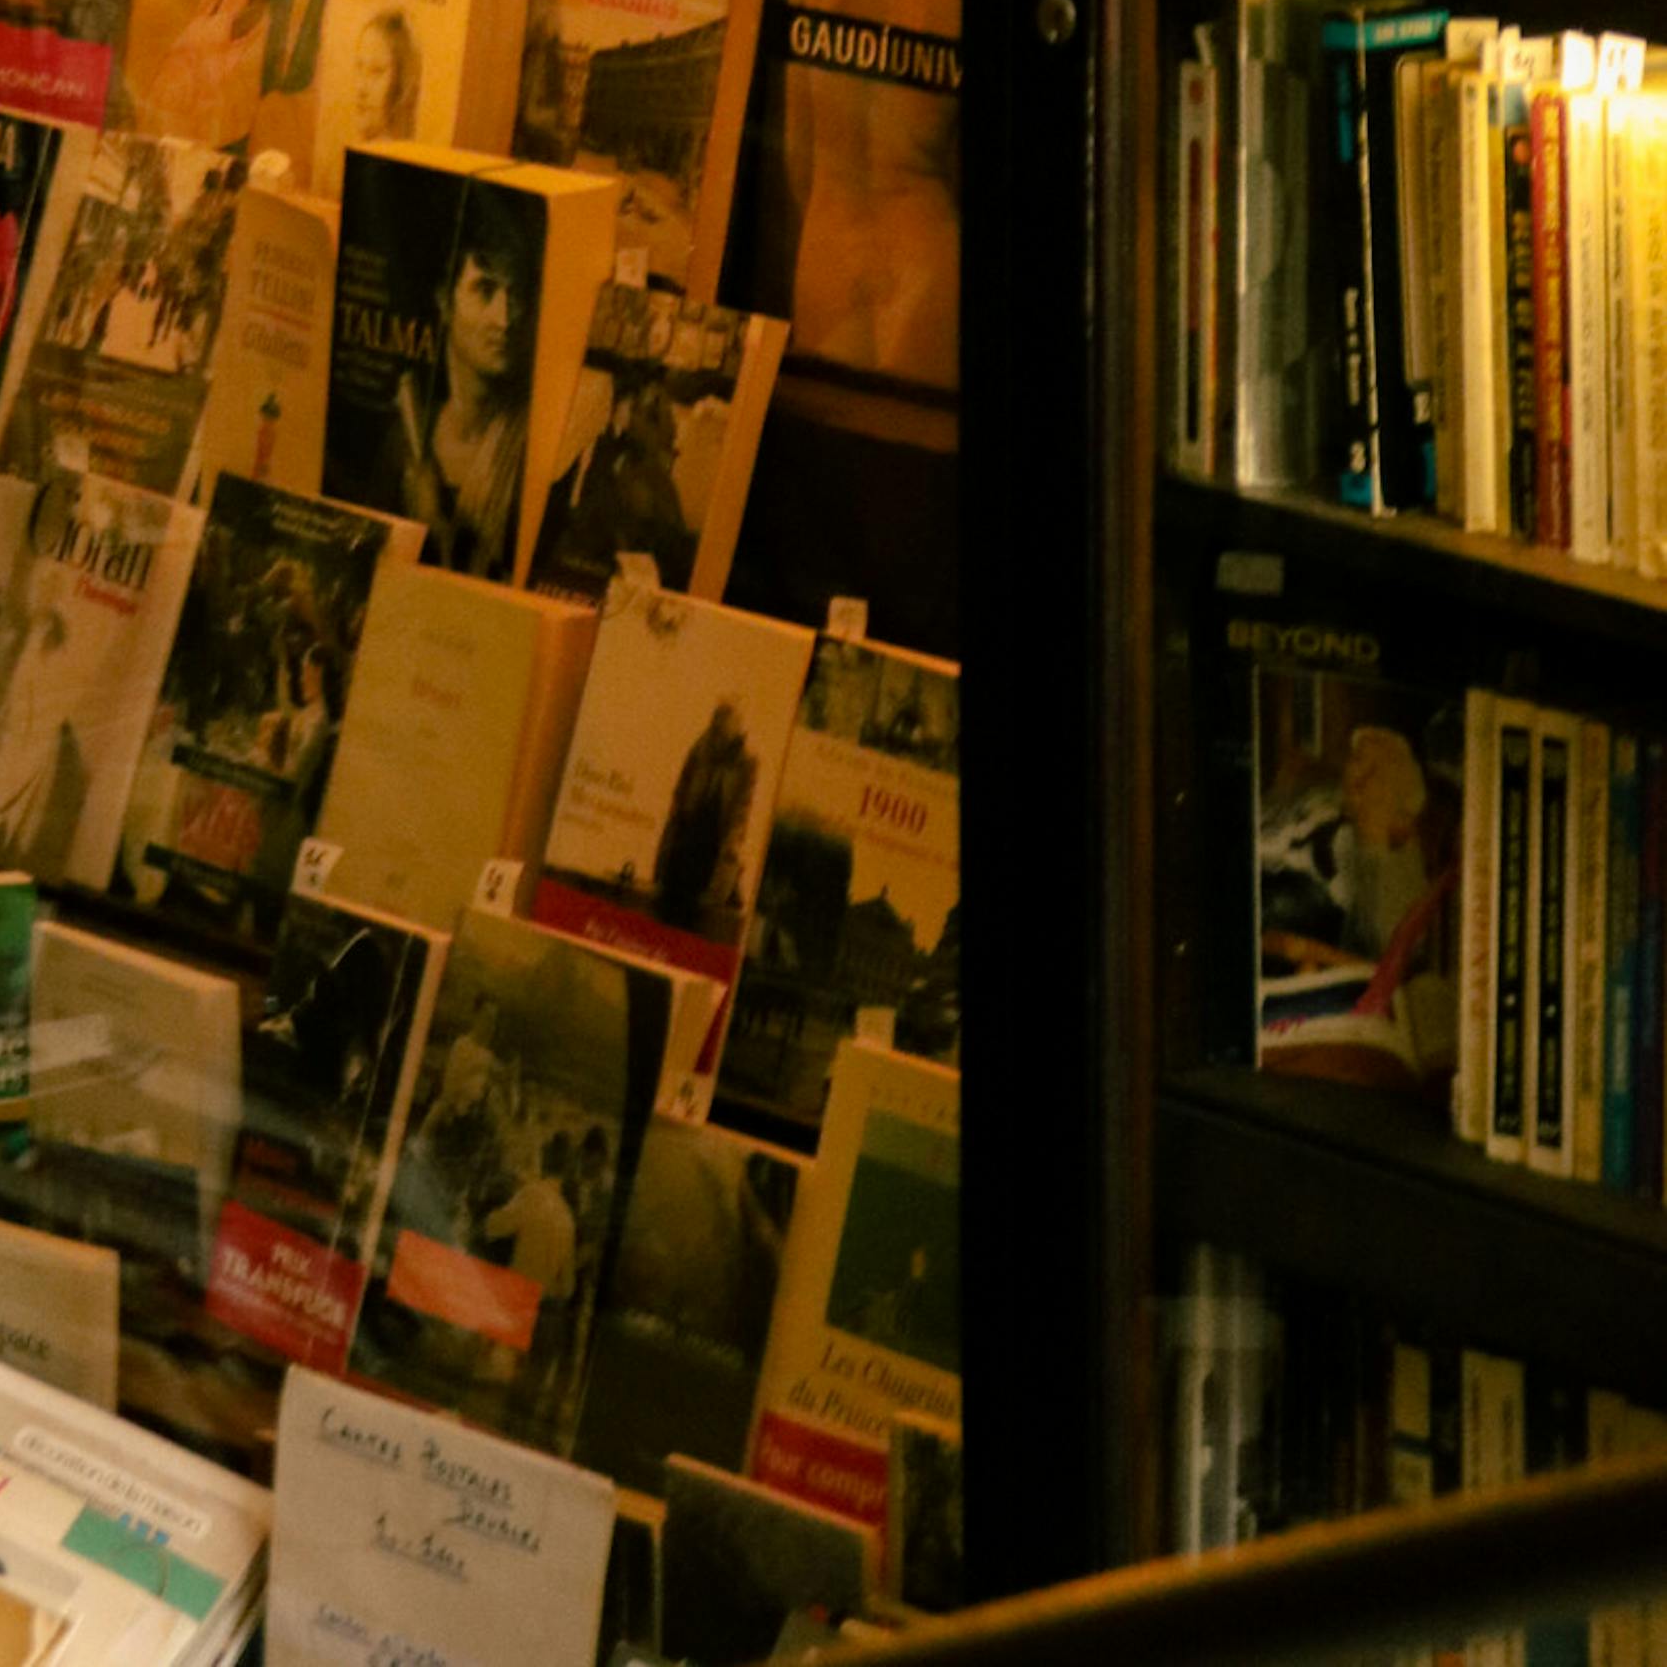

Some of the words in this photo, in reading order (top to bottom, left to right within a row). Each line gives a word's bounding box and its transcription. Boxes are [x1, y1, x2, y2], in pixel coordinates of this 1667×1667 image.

[340, 302, 435, 361] TALMA
[1225, 618, 1383, 665] BEYOND
[859, 784, 928, 837] 1900
